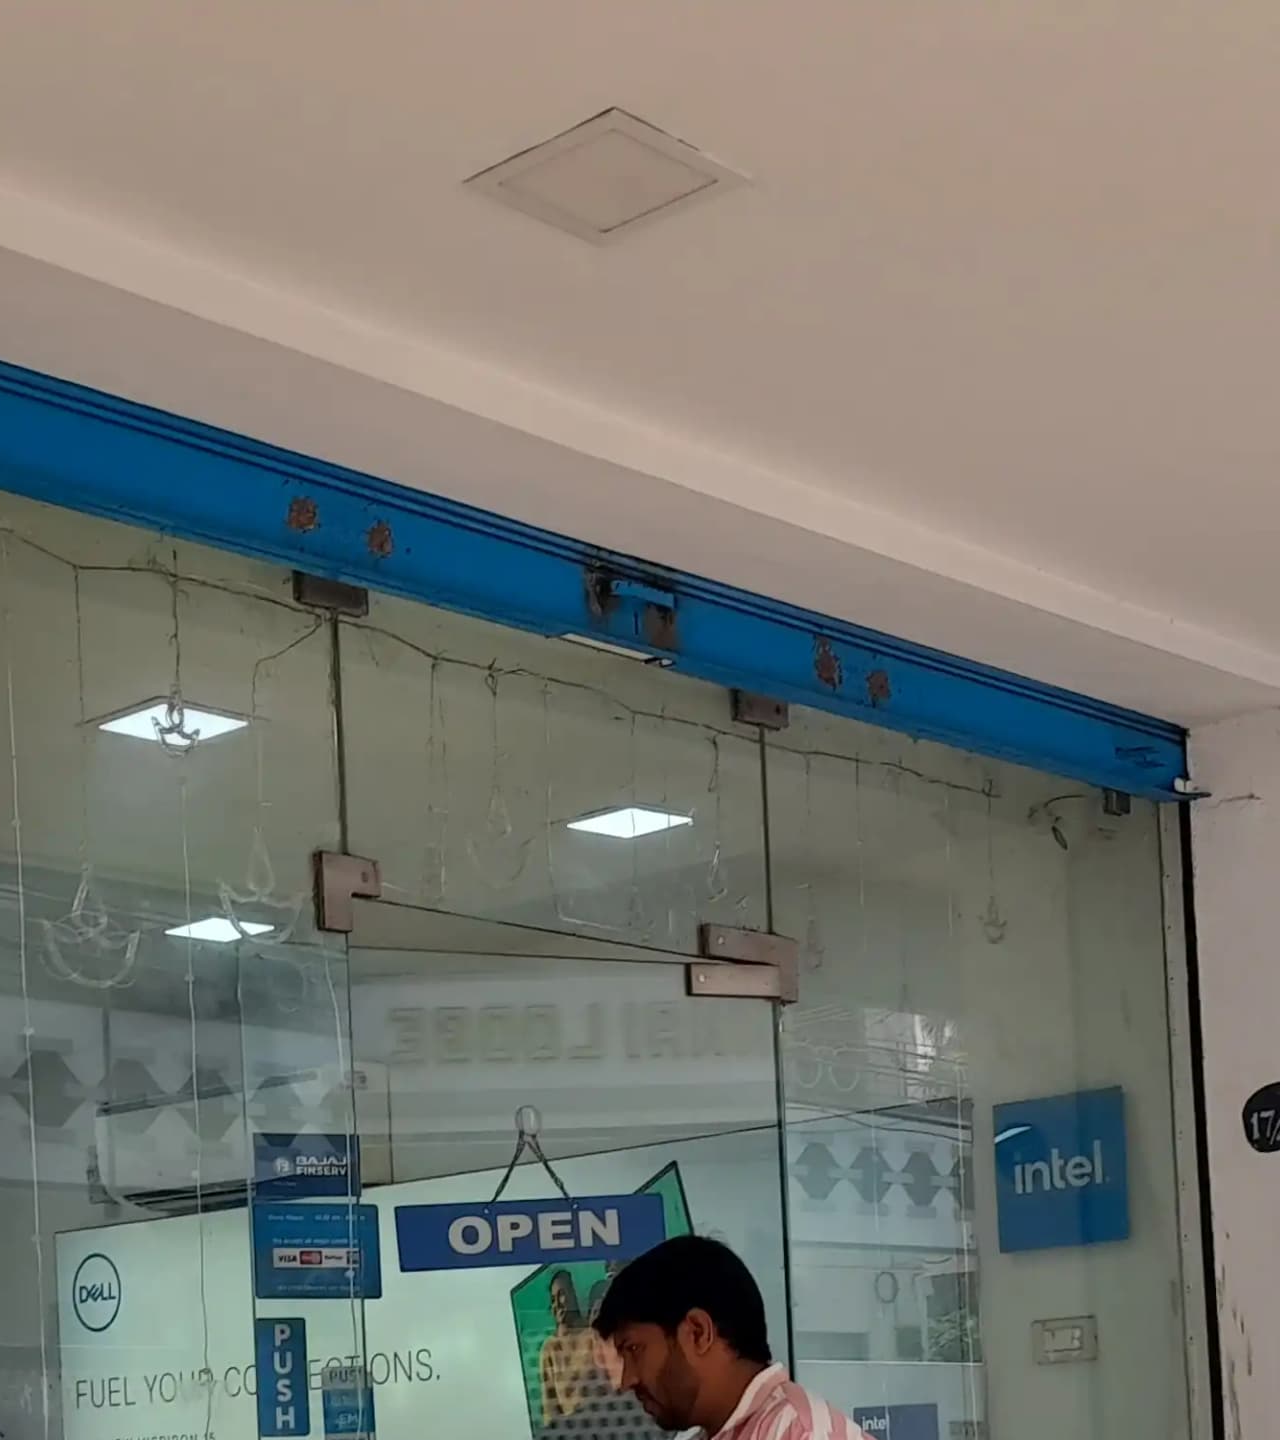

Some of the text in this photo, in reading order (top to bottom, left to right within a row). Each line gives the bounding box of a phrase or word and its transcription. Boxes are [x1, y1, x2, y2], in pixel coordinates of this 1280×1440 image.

[1013, 1140, 1103, 1194] intel
[447, 1208, 621, 1256] OPEN
[74, 1377, 137, 1409] FUEL
[271, 1322, 296, 1431] PUSH
